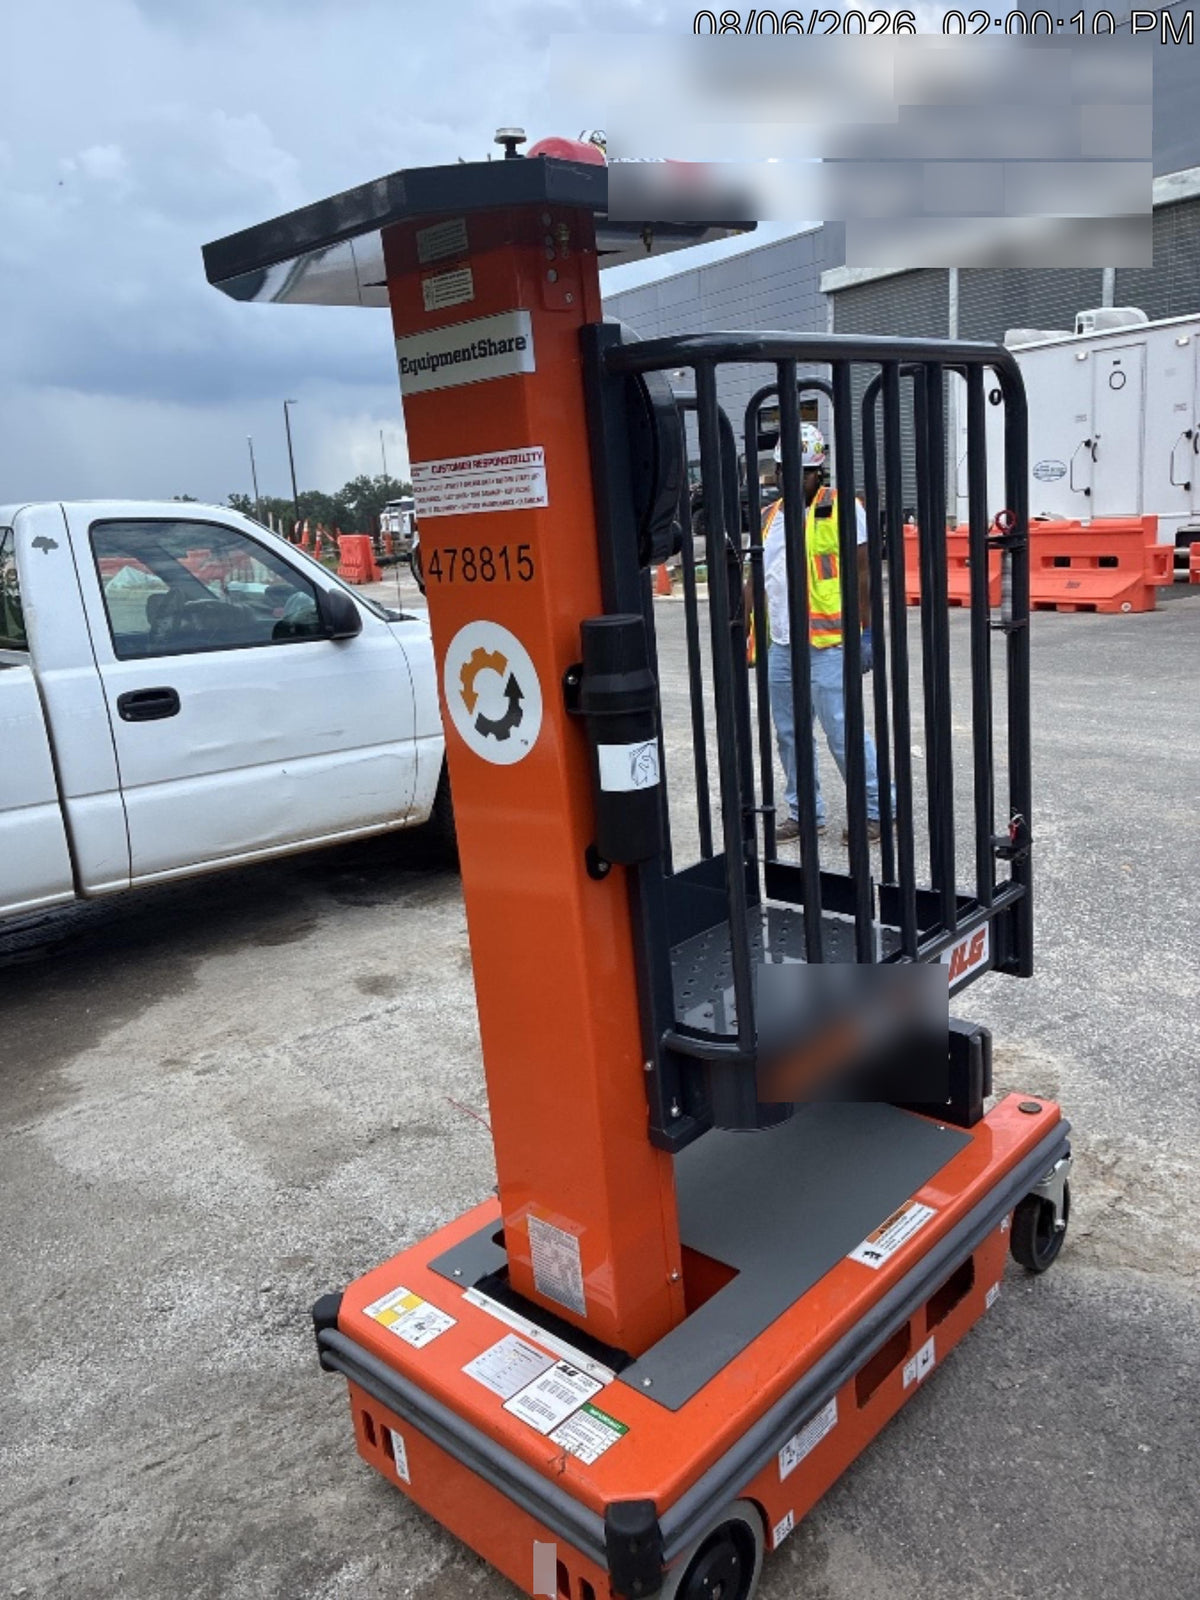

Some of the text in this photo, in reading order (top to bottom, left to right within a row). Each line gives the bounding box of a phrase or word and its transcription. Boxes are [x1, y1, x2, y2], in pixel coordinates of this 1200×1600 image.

[400, 336, 526, 375] EquipmentShare
[431, 460, 472, 474] CUSTOMER
[473, 451, 543, 469] RESPONSIBILITY
[429, 544, 534, 582] 478815
